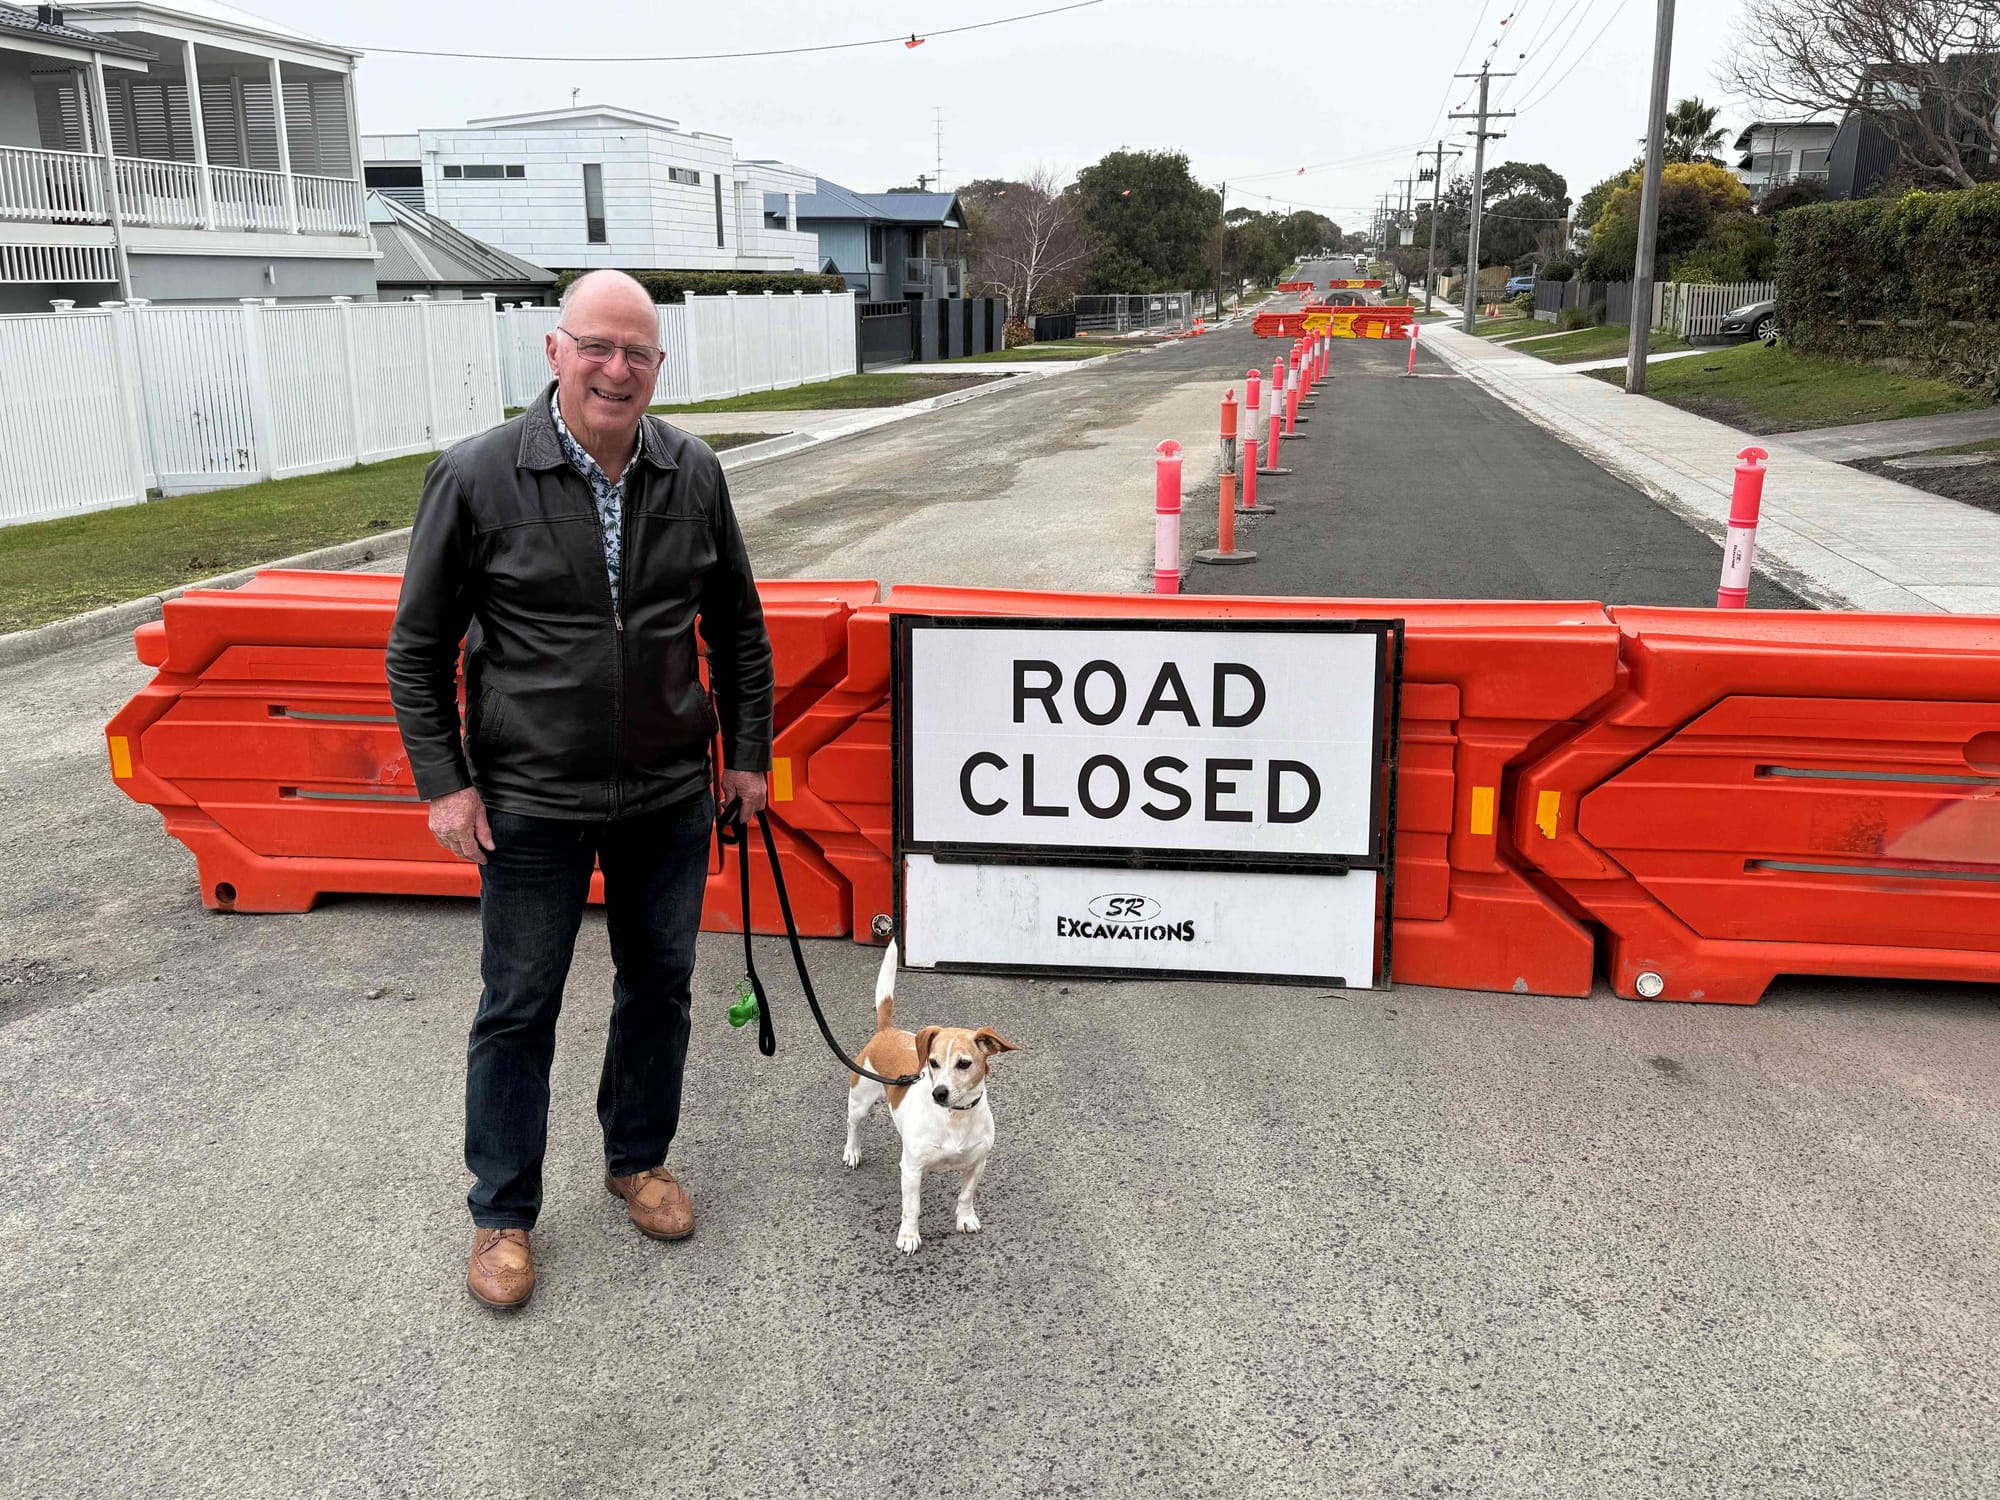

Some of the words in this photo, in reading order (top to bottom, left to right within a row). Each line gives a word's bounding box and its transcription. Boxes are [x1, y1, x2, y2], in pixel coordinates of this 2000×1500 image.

[1012, 659, 1266, 728] ROAD
[959, 751, 1322, 824] CLOSED
[1057, 915, 1195, 942] EXCAVATIONS
[1105, 897, 1145, 917] SR
